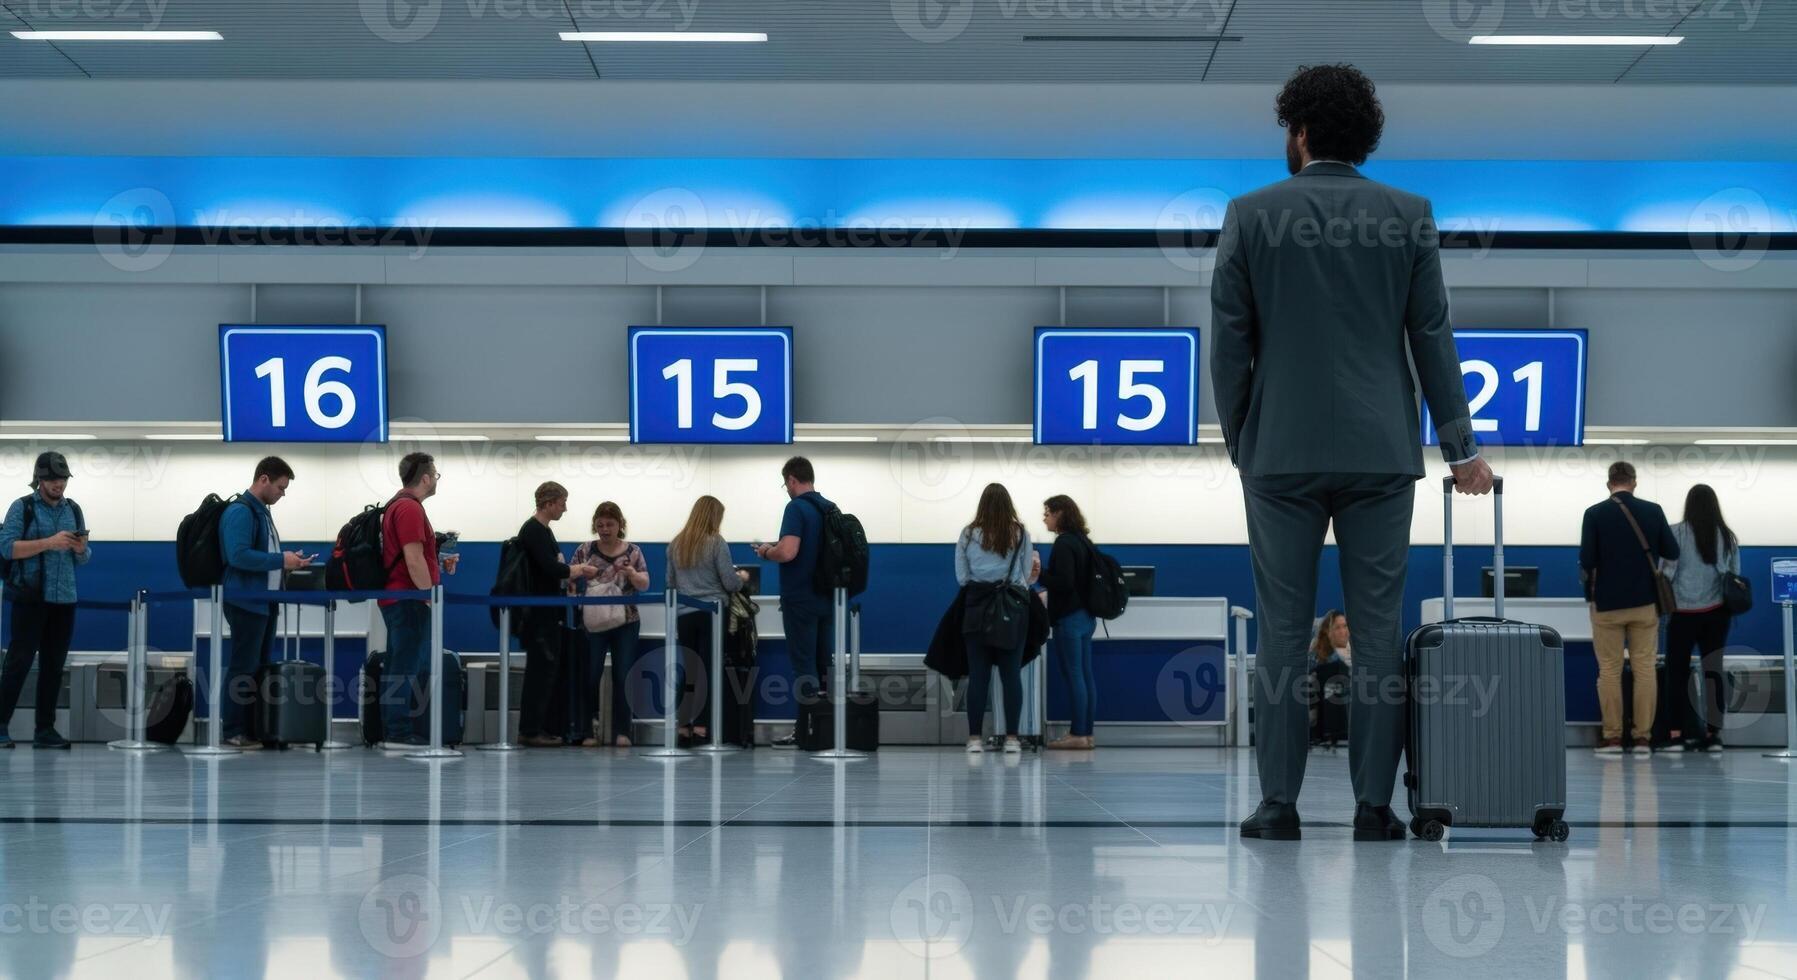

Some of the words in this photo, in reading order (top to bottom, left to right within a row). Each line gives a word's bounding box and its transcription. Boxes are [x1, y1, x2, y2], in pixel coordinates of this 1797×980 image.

[255, 357, 355, 428] 16
[663, 359, 761, 430] 15
[1069, 360, 1165, 431] 15
[1460, 360, 1542, 431] 21
